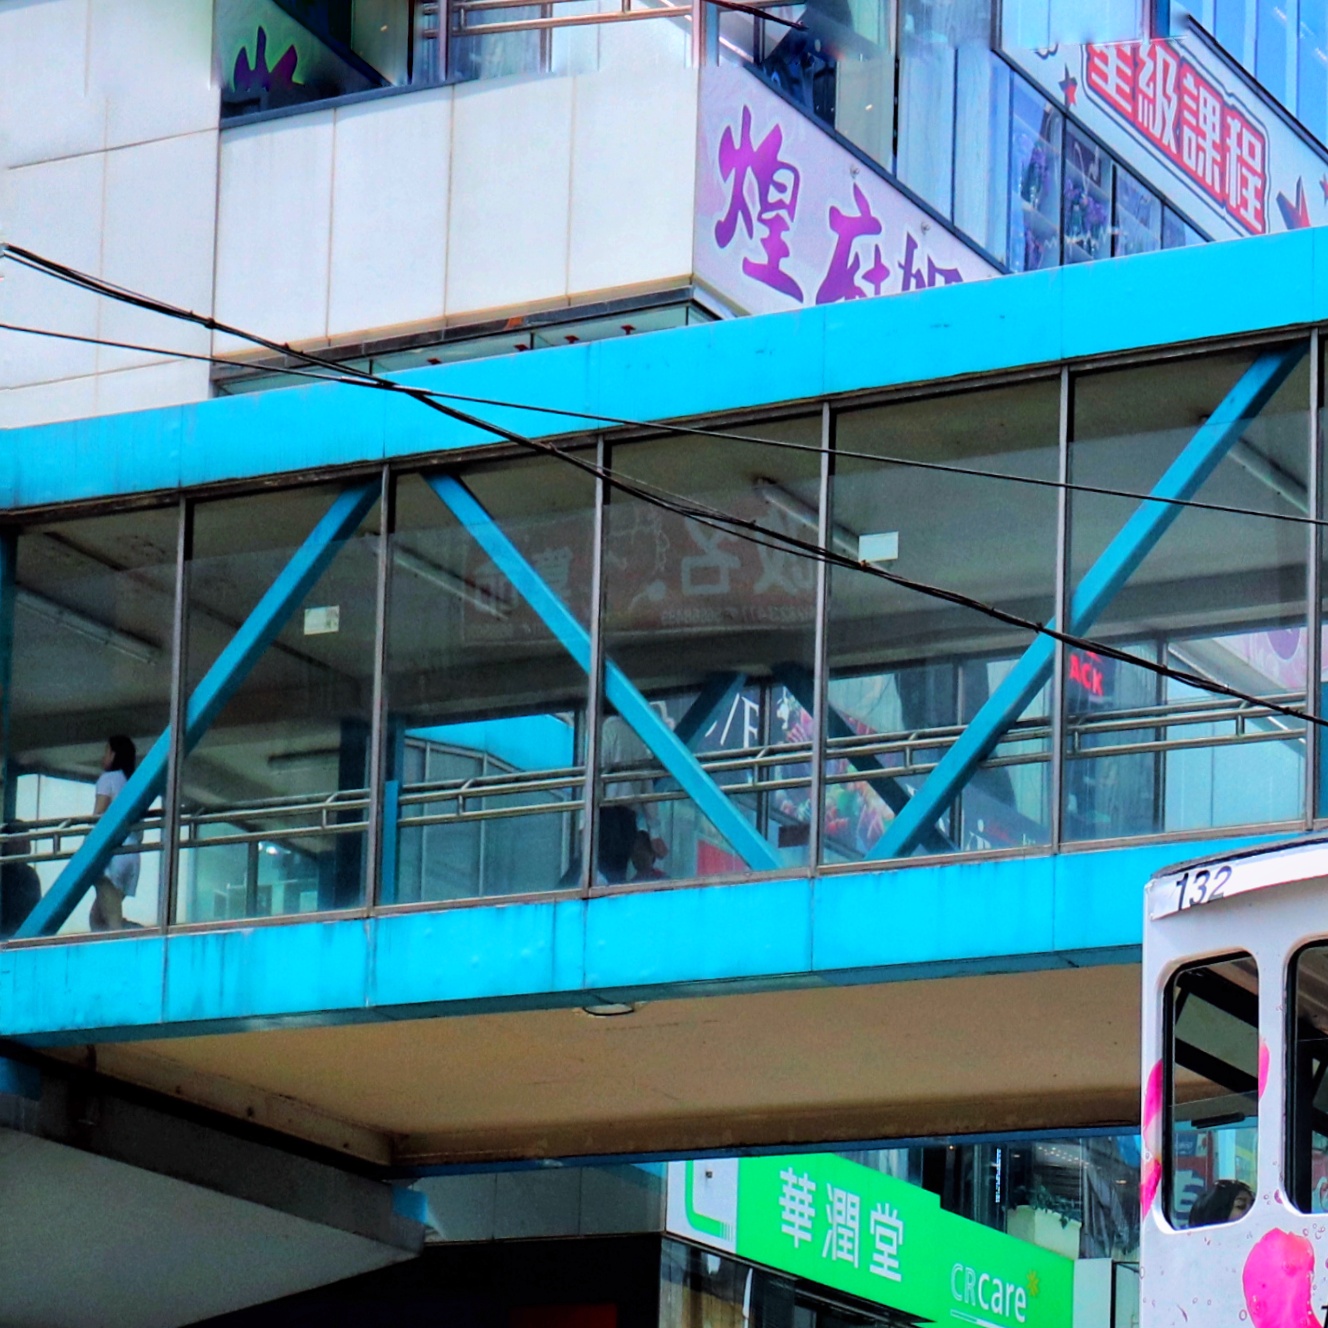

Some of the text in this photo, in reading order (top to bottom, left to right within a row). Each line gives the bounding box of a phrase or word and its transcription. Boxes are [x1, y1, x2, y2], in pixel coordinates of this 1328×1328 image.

[1176, 865, 1233, 907] 132
[779, 1166, 904, 1283] 華潤堂
